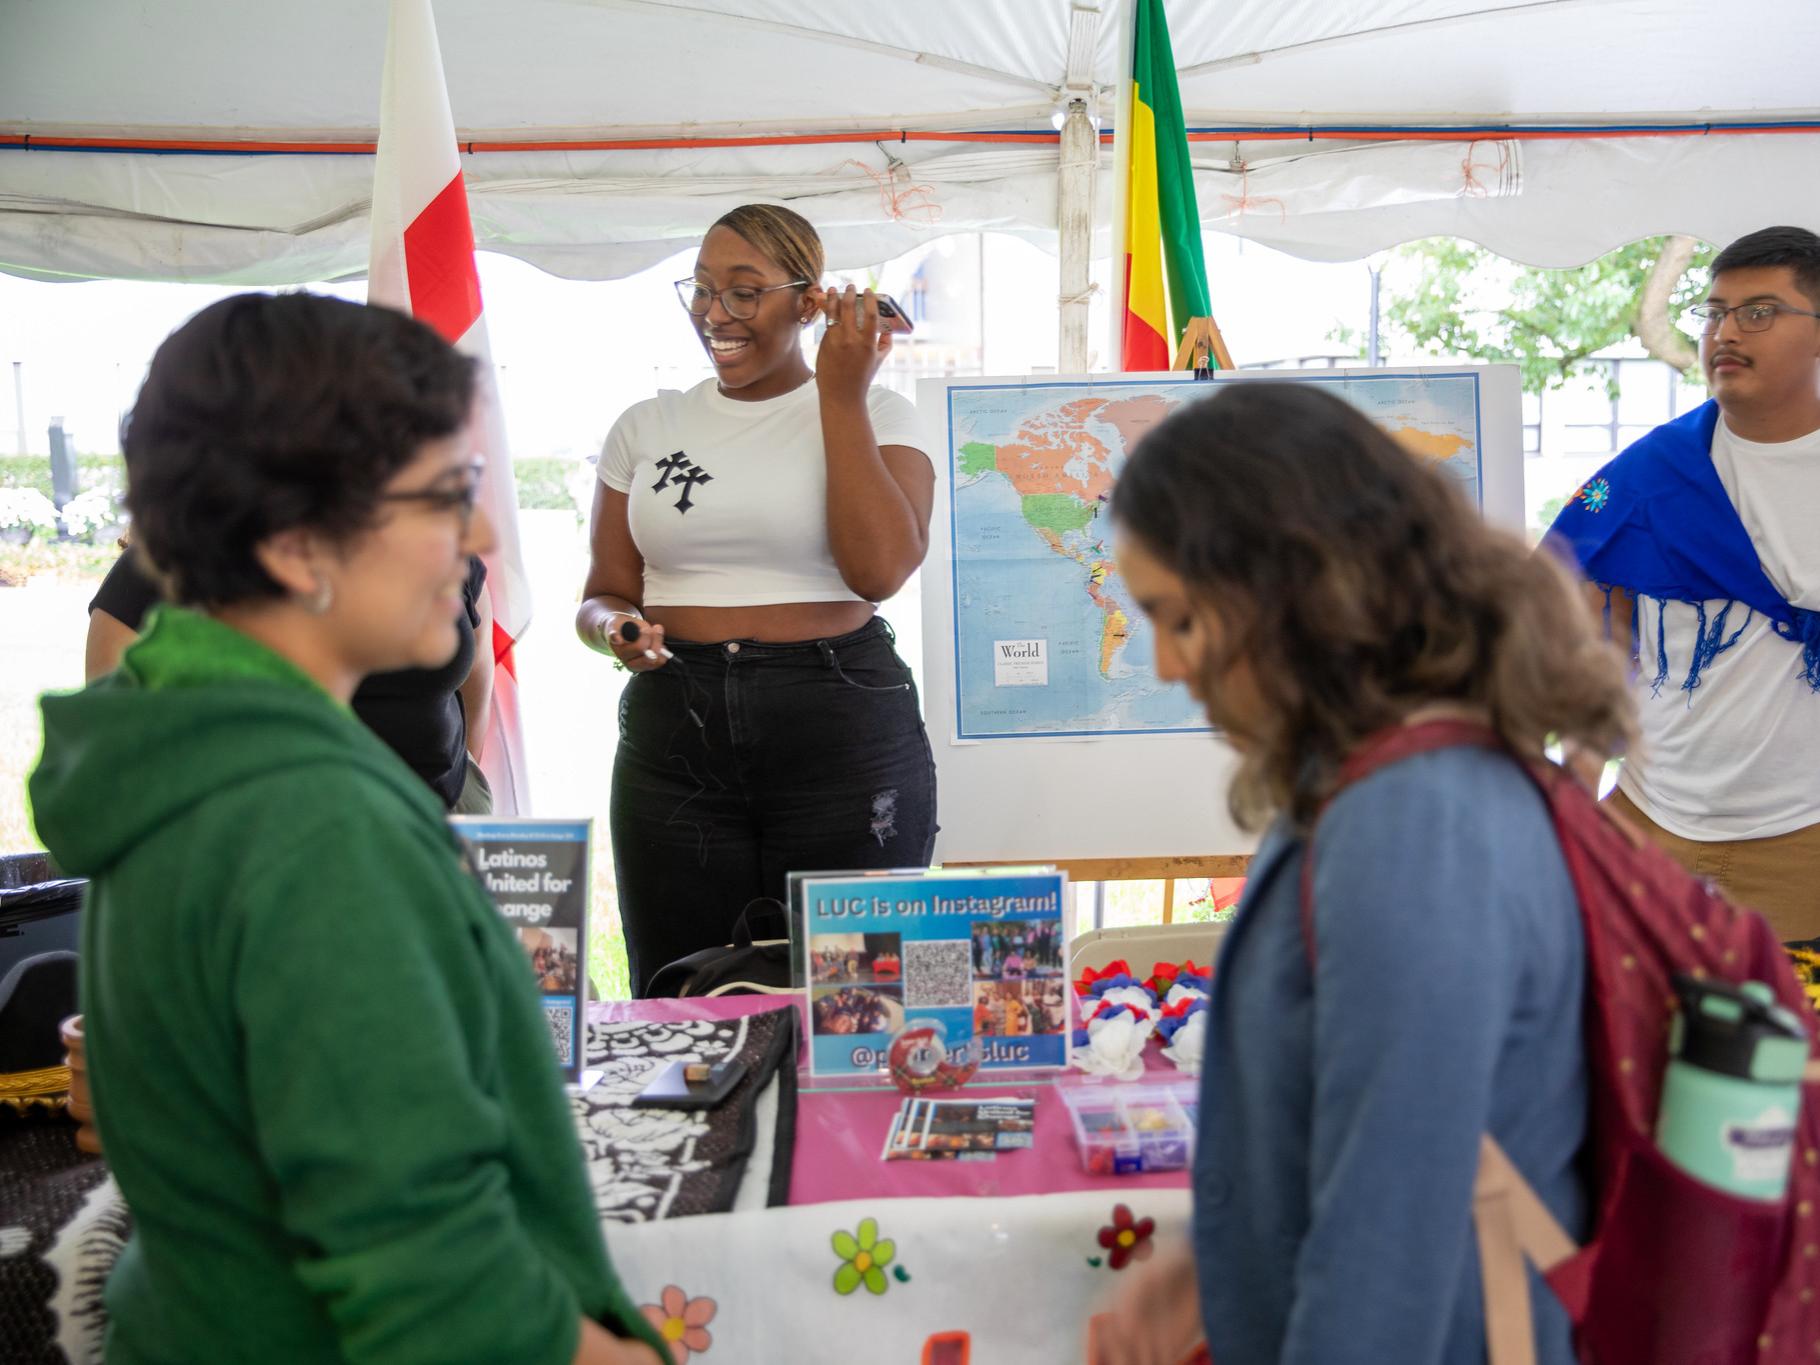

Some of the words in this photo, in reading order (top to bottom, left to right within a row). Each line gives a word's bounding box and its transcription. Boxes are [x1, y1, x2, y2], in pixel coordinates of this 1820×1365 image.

[1000, 642, 1040, 658] World
[478, 847, 548, 870] Latinos
[543, 872, 573, 892] for
[816, 897, 867, 920] LUC
[870, 896, 893, 917] is
[896, 898, 927, 917] on
[932, 891, 1057, 918] Instagram!
